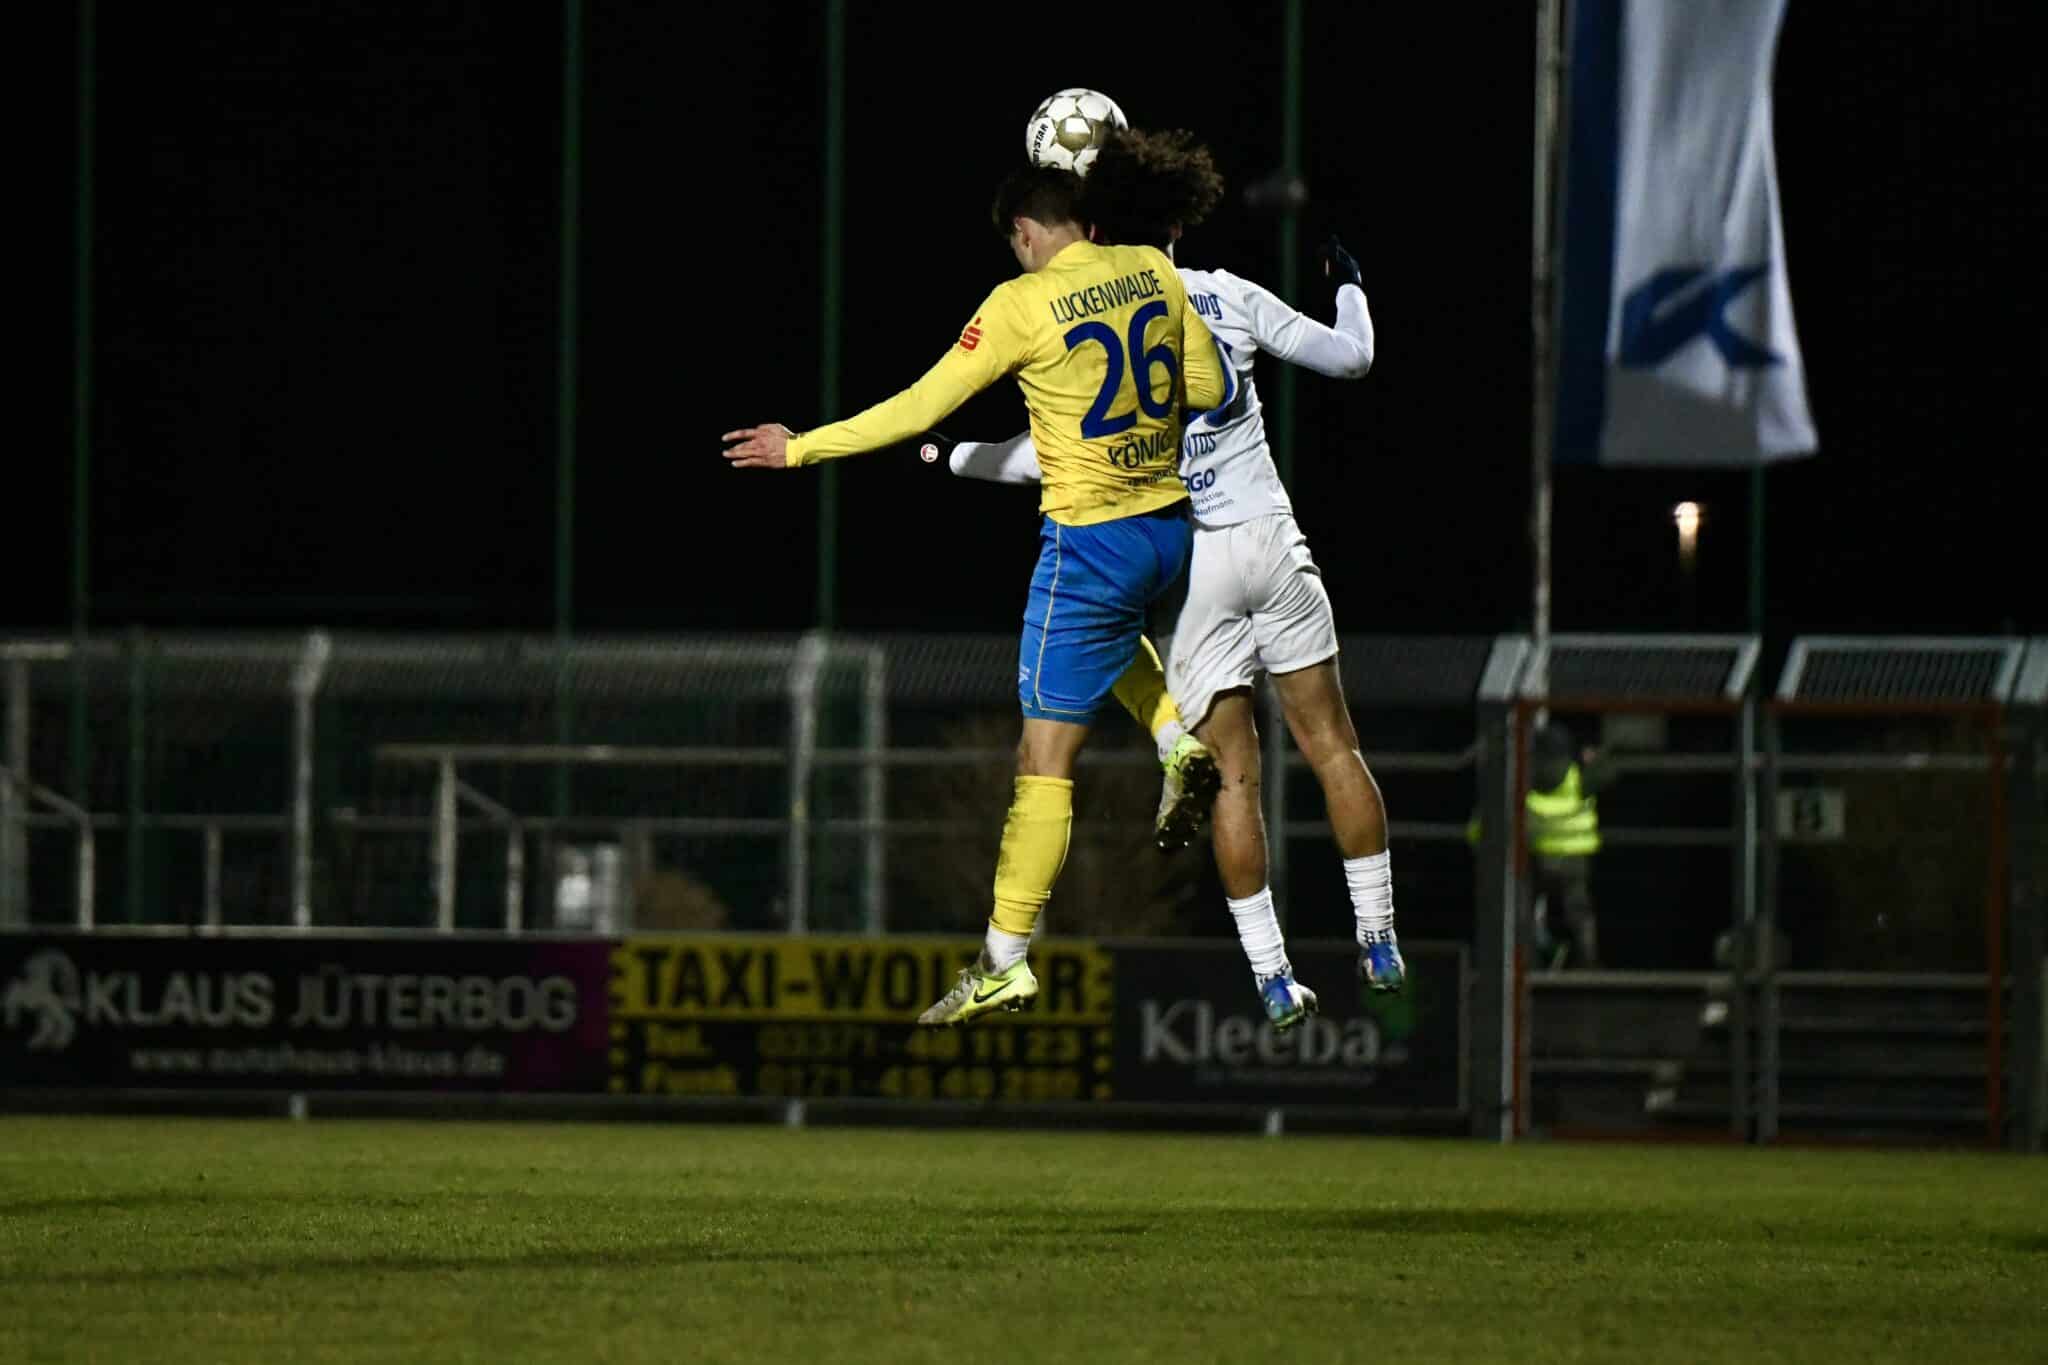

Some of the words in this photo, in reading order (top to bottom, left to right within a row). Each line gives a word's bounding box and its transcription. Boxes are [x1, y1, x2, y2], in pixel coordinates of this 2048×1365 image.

[1050, 269, 1165, 325] LUCKENWALDE
[1063, 300, 1179, 440] 26
[85, 970, 275, 1028] KLAUS
[290, 961, 578, 1032] JÜTERBOG
